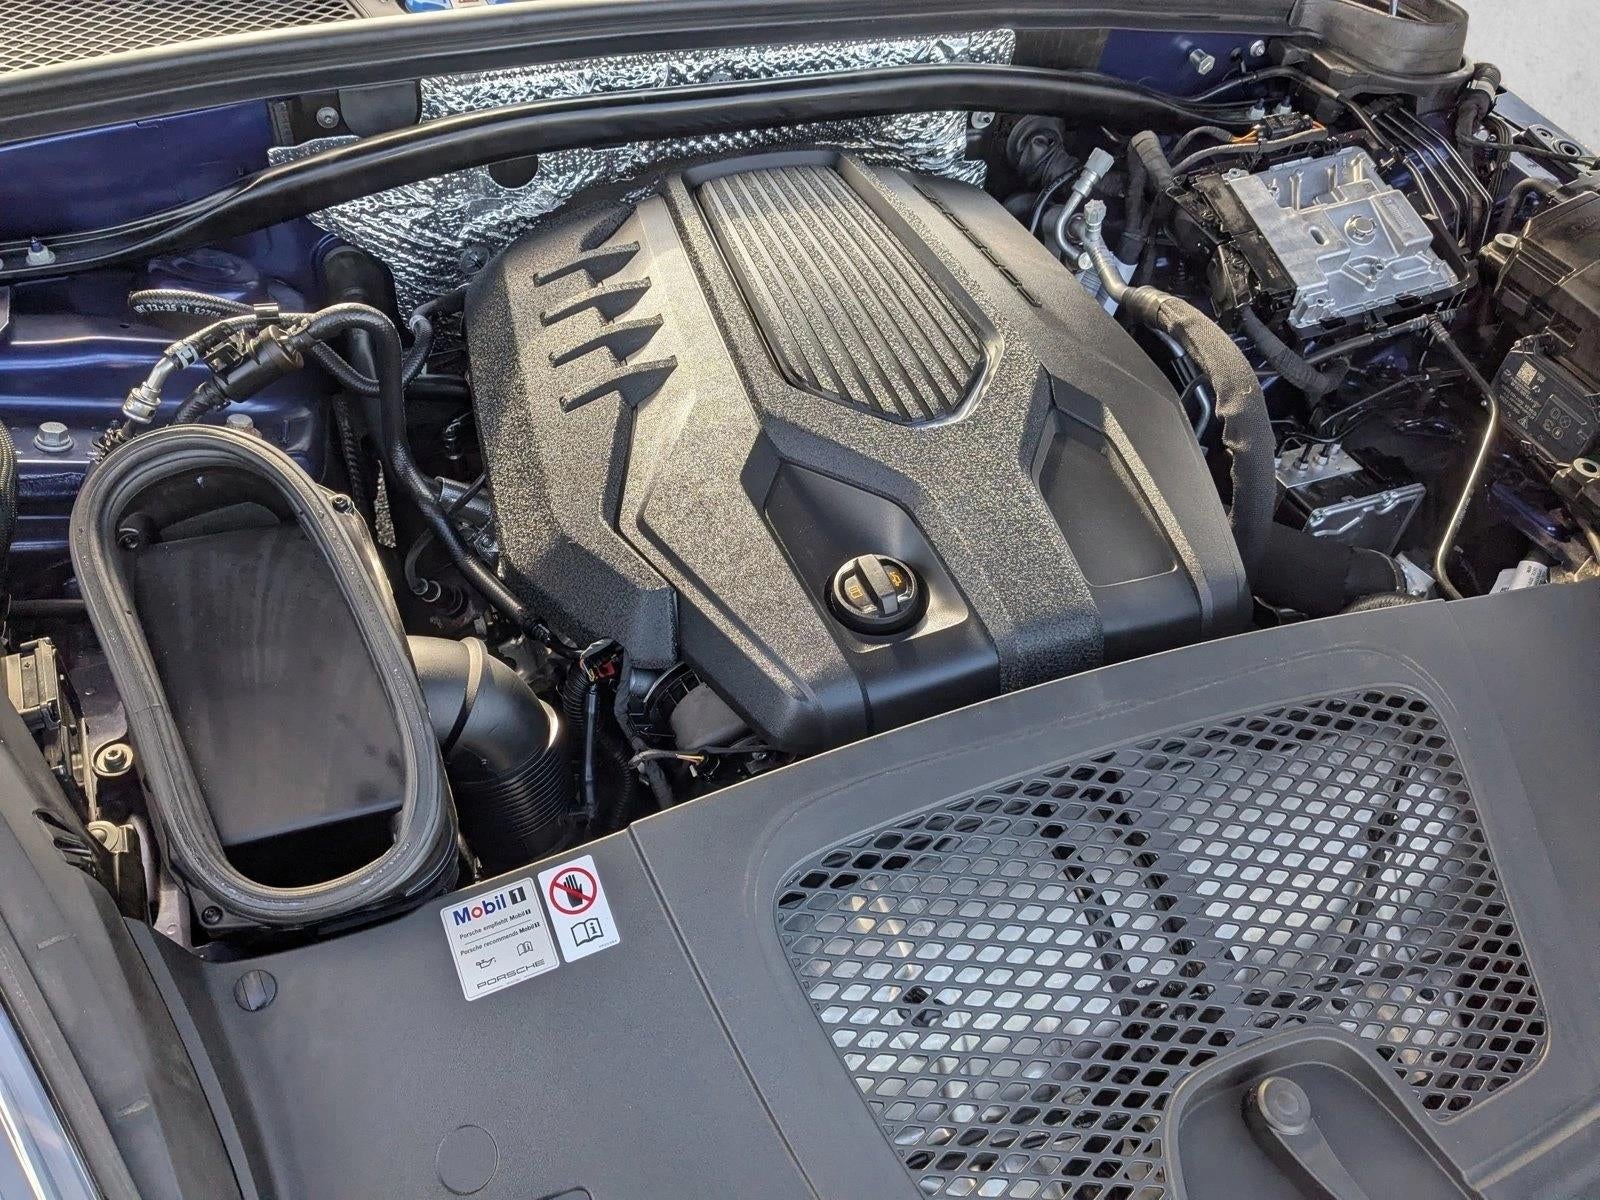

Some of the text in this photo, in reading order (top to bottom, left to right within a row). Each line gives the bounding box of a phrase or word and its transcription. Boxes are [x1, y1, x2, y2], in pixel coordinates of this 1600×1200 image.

[452, 893, 507, 926] Mobil
[459, 928, 482, 940] Porsche
[483, 918, 509, 931] empfiehlt
[460, 944, 483, 956] Porsche
[483, 929, 519, 948] recommends
[476, 958, 546, 990] PORSCHE
